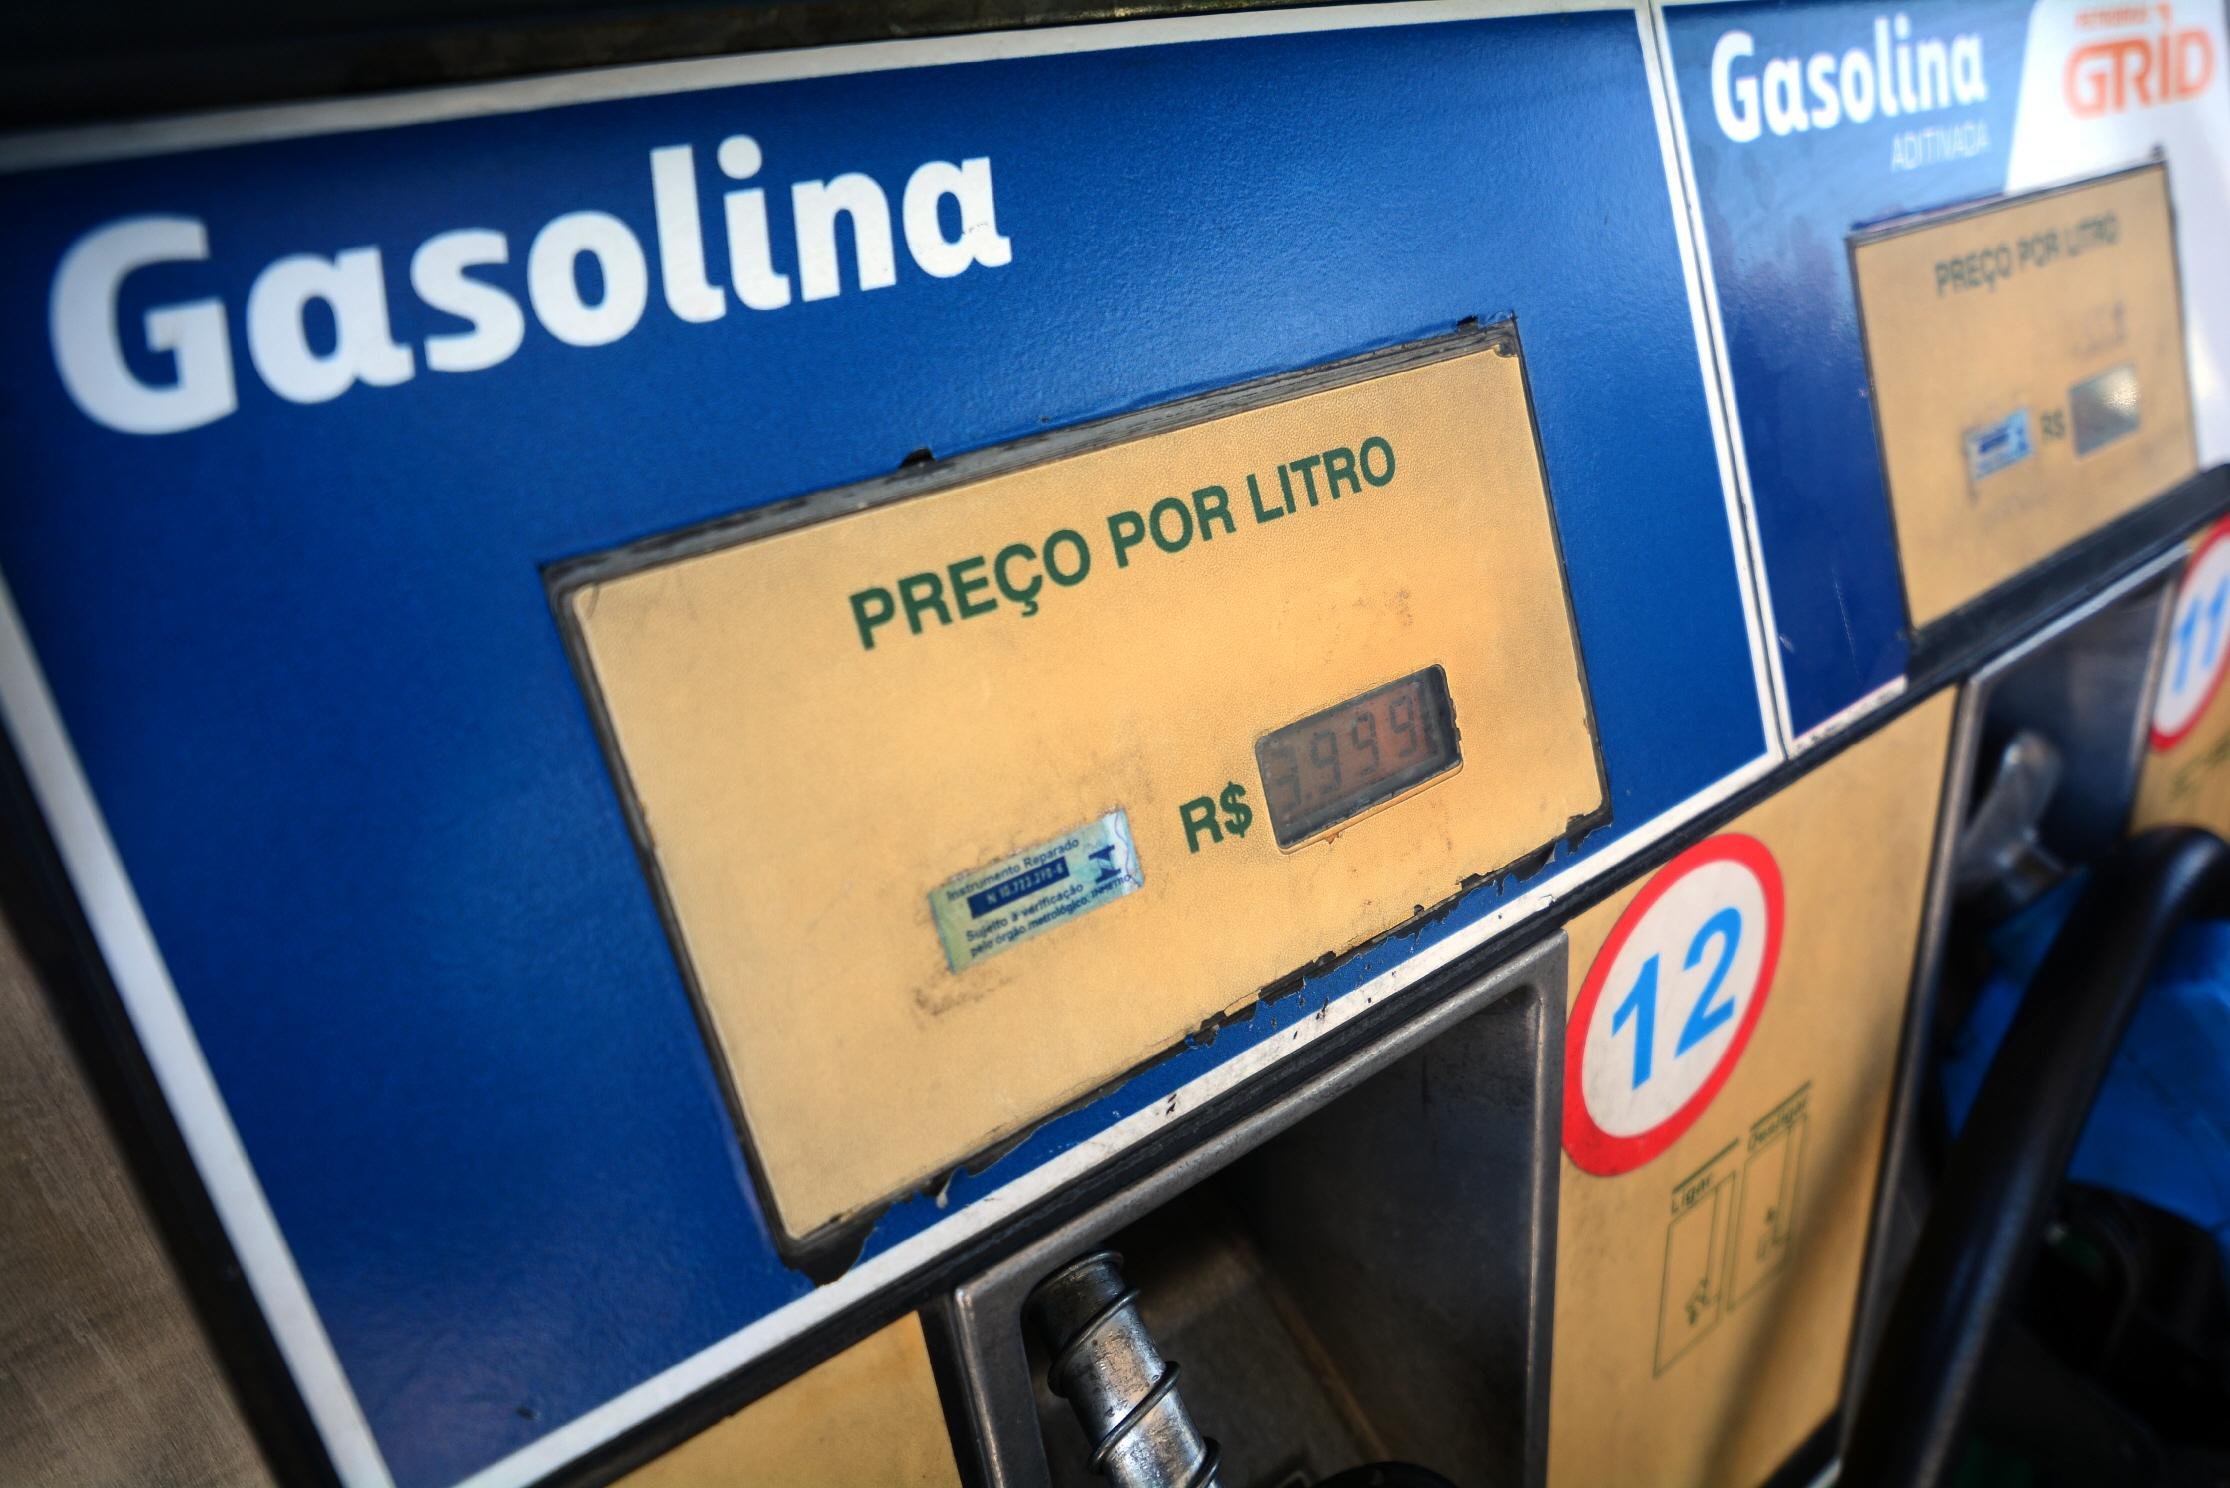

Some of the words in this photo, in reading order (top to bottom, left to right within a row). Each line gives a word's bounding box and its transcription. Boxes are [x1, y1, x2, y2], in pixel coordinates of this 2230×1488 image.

[1711, 14, 1989, 143] Gasolina
[2063, 27, 2216, 119] GRID
[48, 134, 1012, 436] Gasolina
[1934, 243, 2012, 297] PREÇO
[2018, 227, 2060, 271] POR
[849, 528, 1091, 650] PREÇO
[1107, 484, 1237, 568] POR
[1246, 435, 1397, 524] LITRO
[1179, 781, 1253, 854] R$
[946, 864, 1021, 900] Instrumento
[1023, 838, 1080, 868] Reparado
[965, 917, 1009, 944] Sujeito
[1020, 883, 1085, 918] verificação
[1611, 907, 1743, 1091] 12
